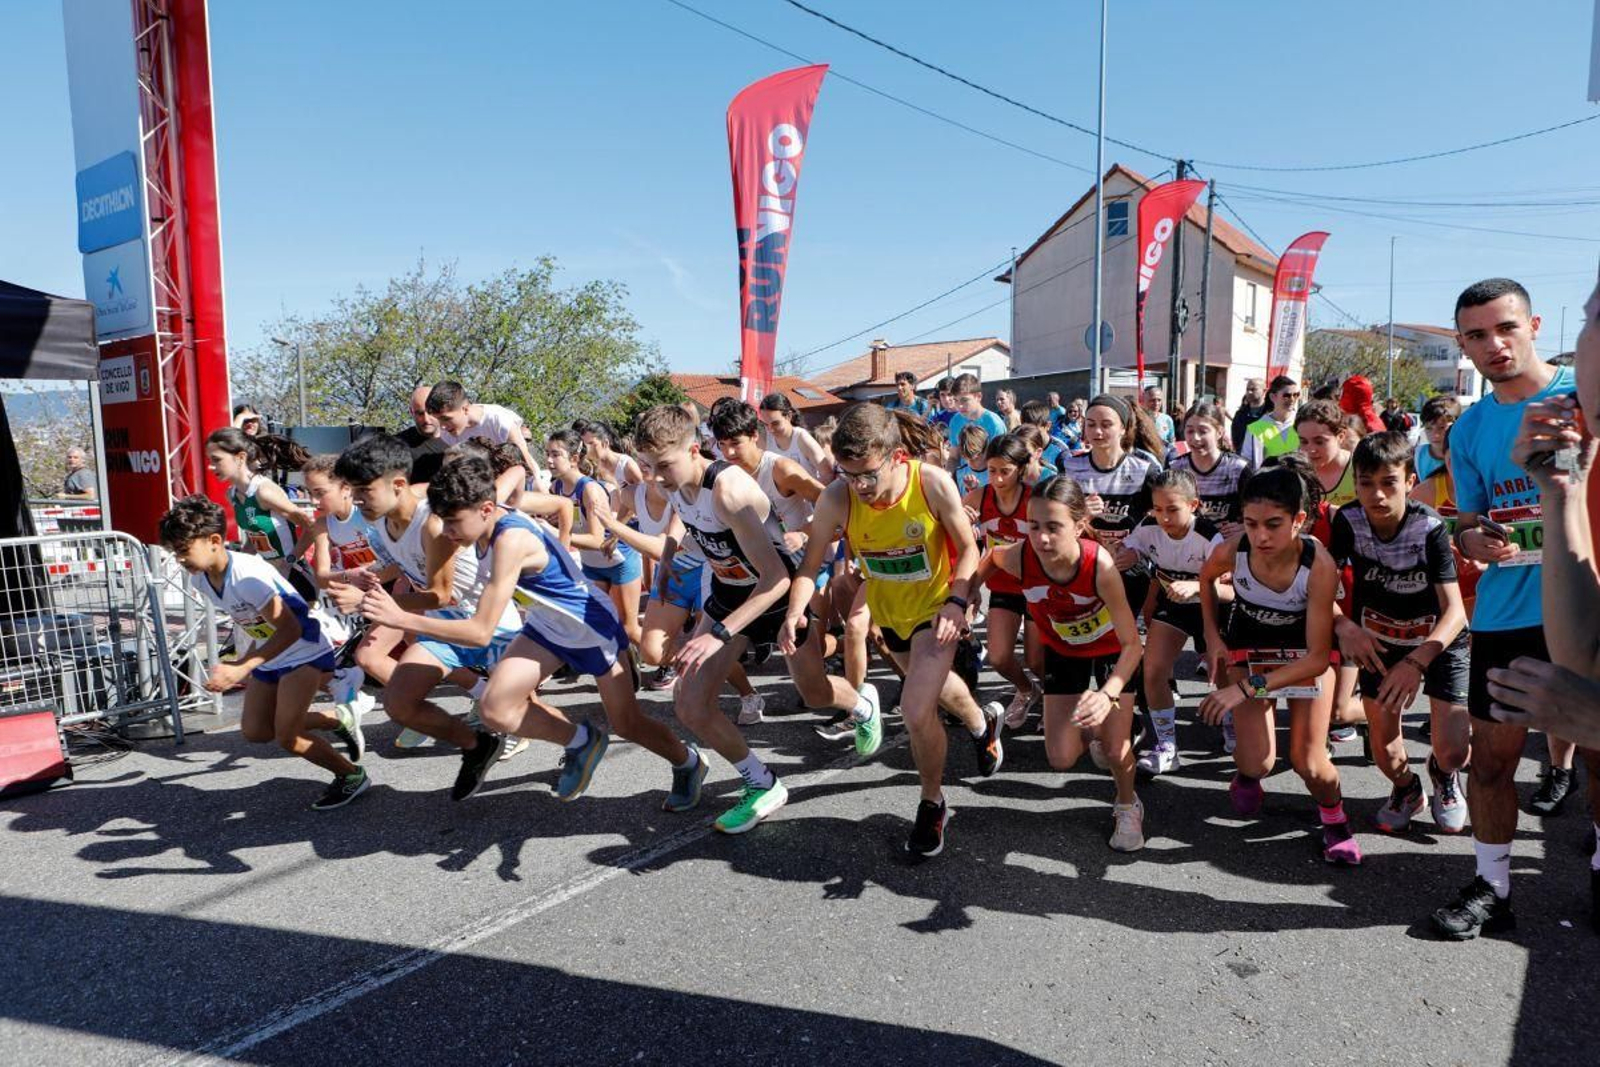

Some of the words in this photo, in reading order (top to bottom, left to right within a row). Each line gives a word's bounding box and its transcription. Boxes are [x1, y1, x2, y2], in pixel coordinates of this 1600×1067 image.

[82, 184, 135, 223] DECATHLON
[100, 365, 132, 381] CONCELLO
[106, 383, 114, 394] DE
[115, 380, 130, 393] VIGO
[1068, 616, 1100, 637] 331
